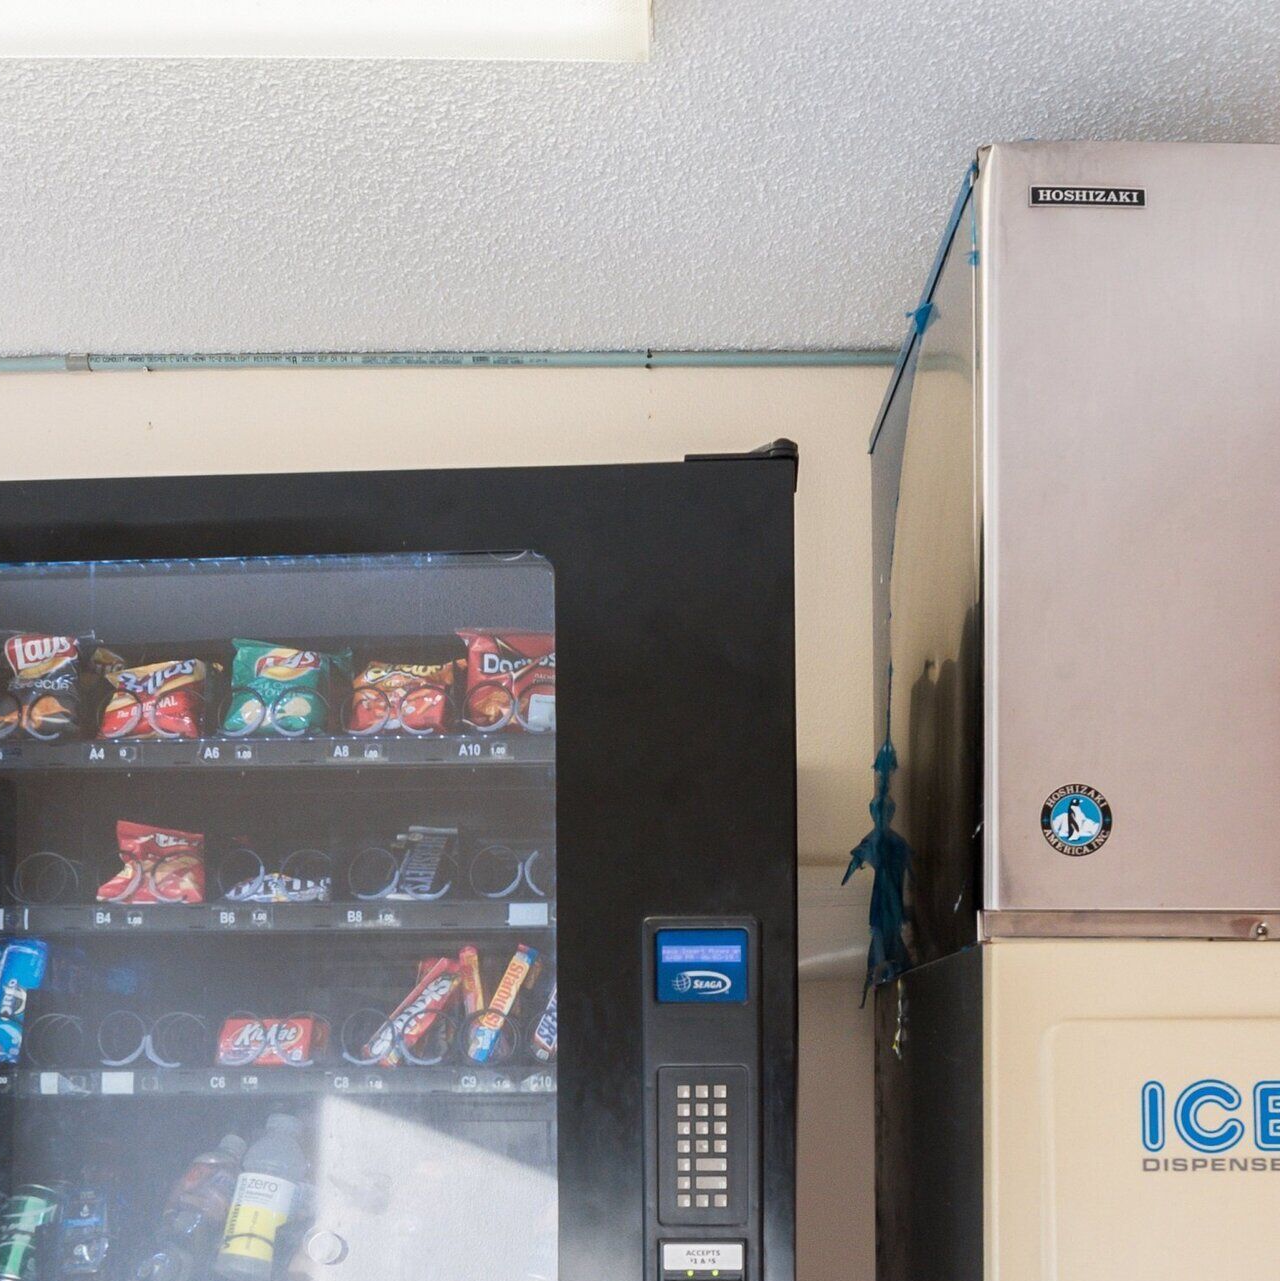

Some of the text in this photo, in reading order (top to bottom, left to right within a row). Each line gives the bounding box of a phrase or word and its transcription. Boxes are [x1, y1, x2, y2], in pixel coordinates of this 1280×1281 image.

[1038, 189, 1140, 203] HOSHIZAKI
[89, 749, 105, 761] A4
[203, 747, 220, 760] A6
[333, 745, 350, 757] A8
[458, 744, 481, 757] A10
[1046, 785, 1108, 809] HOSHIZAKI
[95, 912, 111, 925] B4
[220, 912, 235, 925] B6
[347, 910, 363, 923] B8
[692, 979, 723, 989] SEAGA
[209, 1076, 226, 1089] C6
[334, 1076, 350, 1089] C8
[461, 1075, 477, 1088] C9
[247, 1177, 279, 1193] zero
[685, 1249, 721, 1257] ACCEPTS
